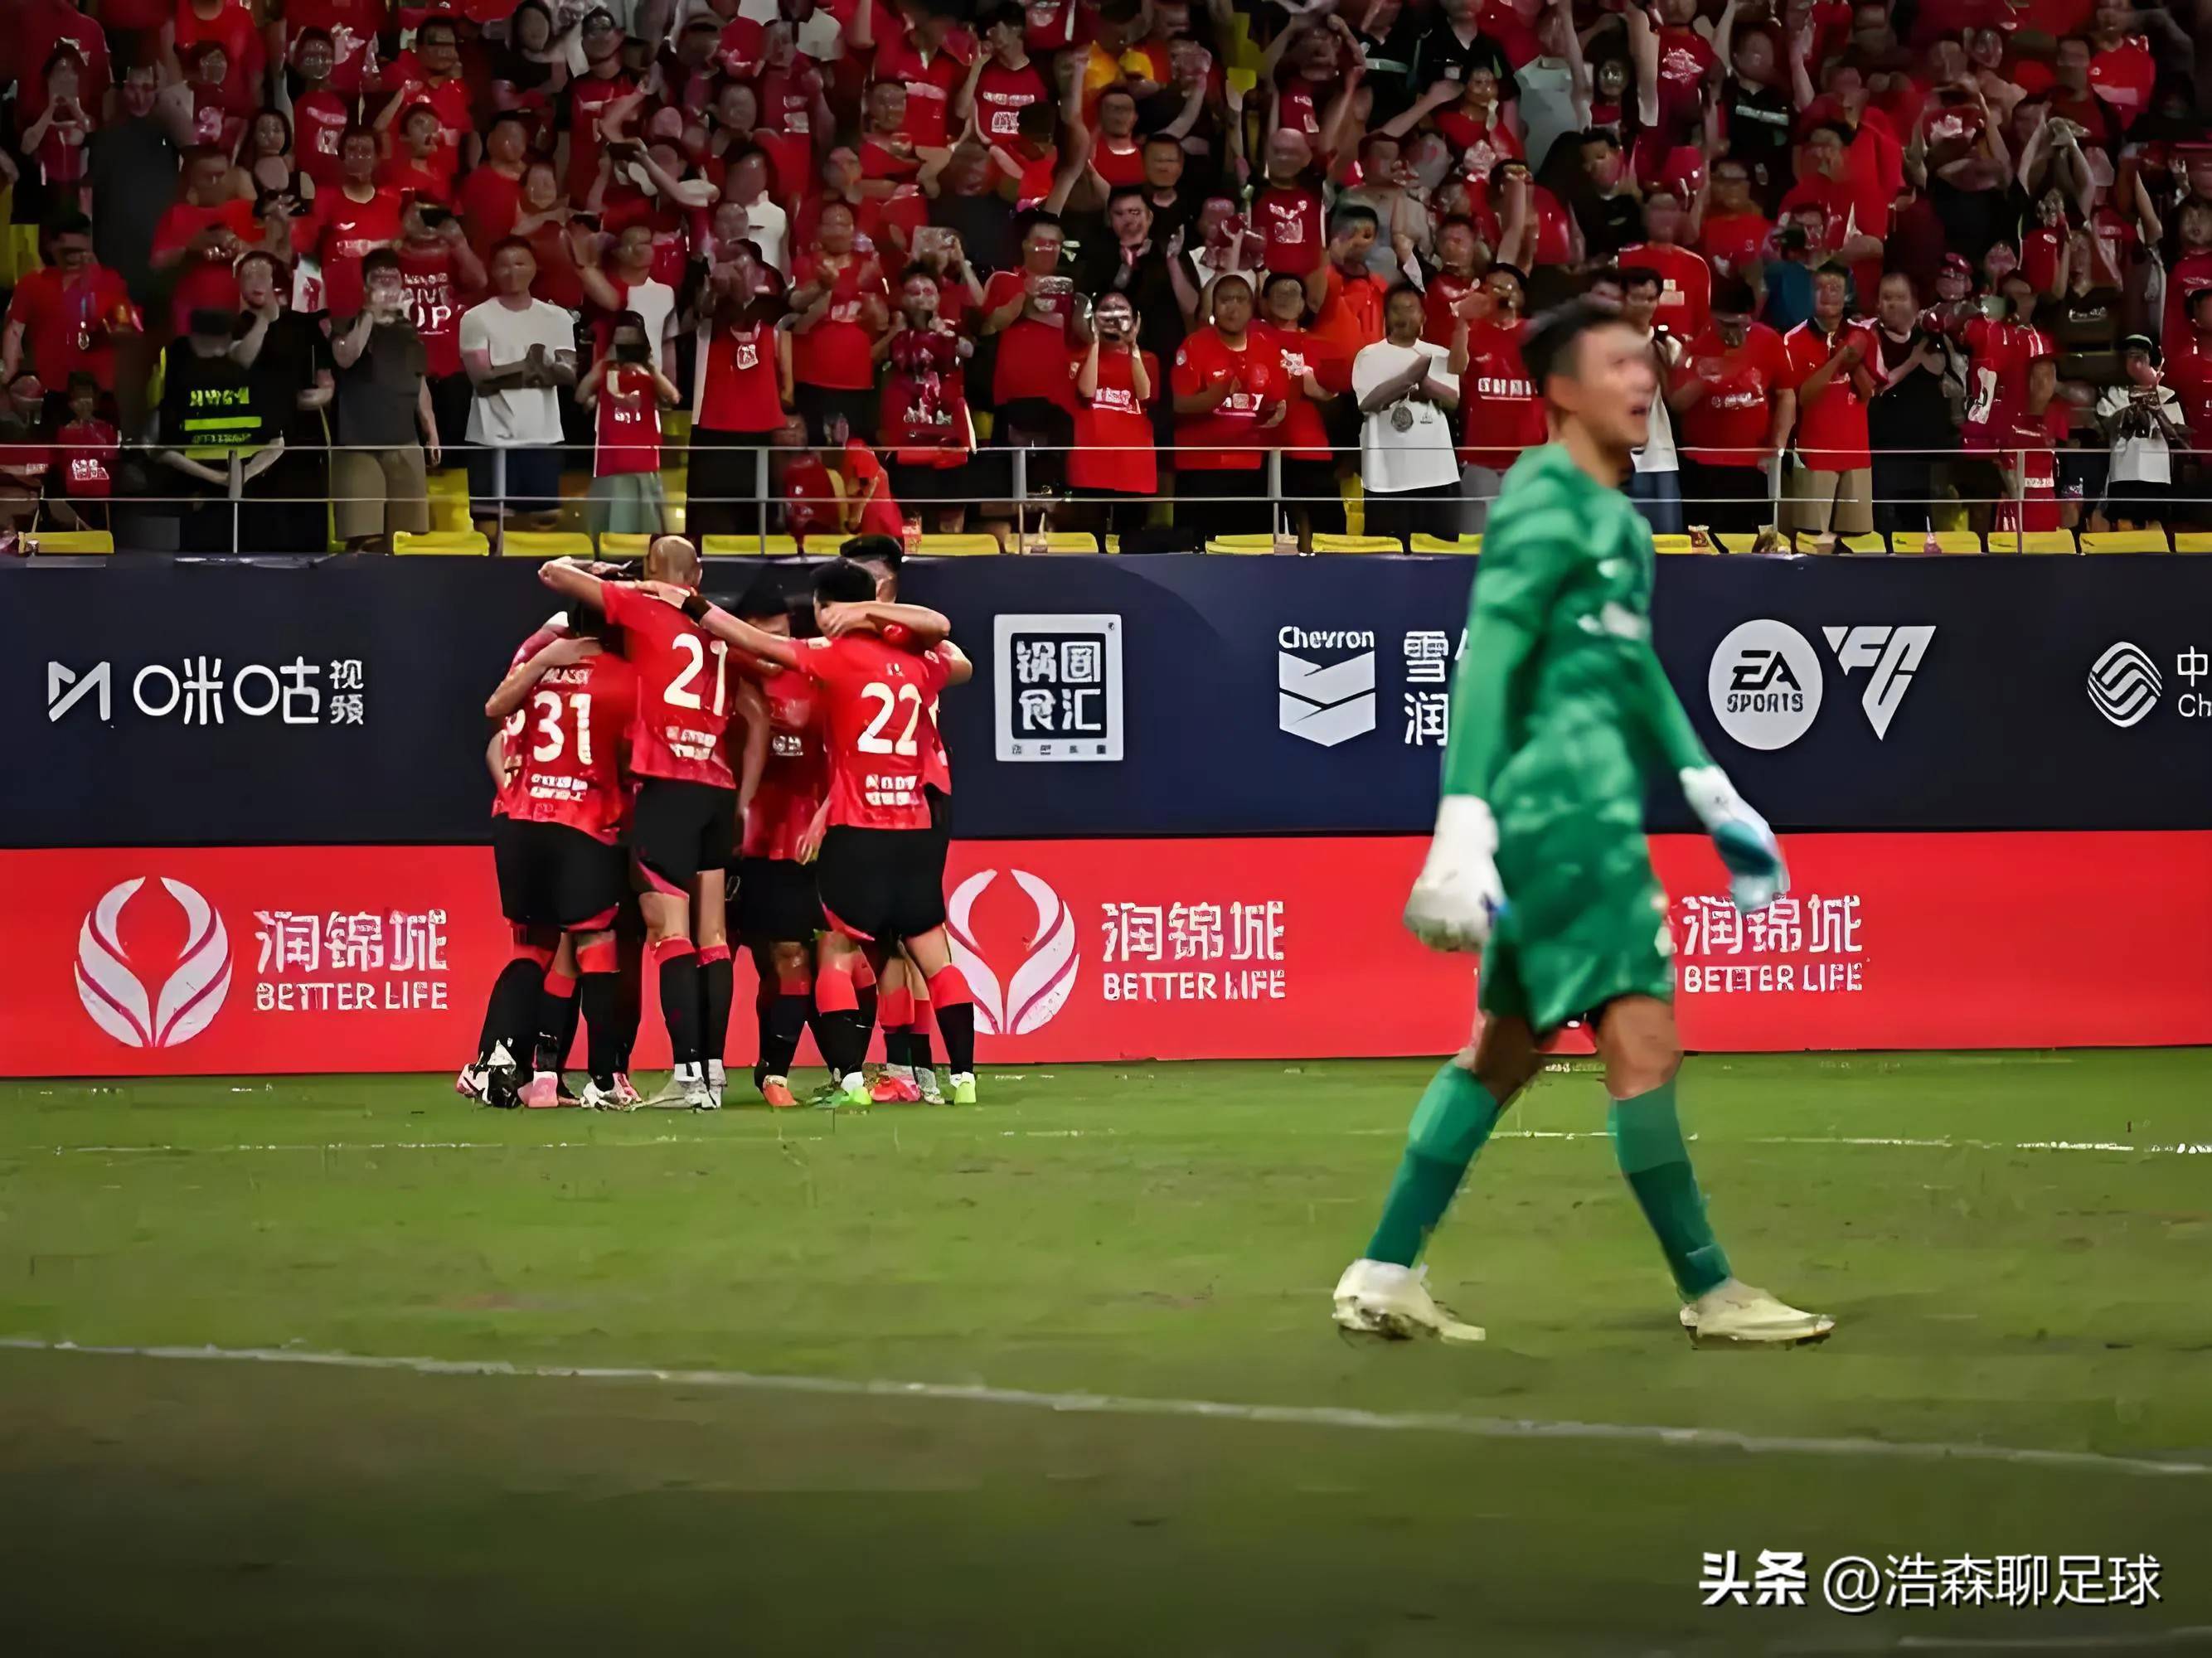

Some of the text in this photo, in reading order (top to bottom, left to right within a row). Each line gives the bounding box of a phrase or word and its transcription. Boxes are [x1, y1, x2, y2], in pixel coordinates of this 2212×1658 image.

[1278, 626, 1375, 648] Chevron
[1404, 628, 1468, 682] 雪
[663, 633, 728, 717] 21
[1729, 650, 1802, 691] EA
[2177, 646, 2209, 687] 中
[857, 681, 922, 757] 22
[1404, 691, 1449, 746] 润
[1726, 693, 1803, 712] SPORTS
[2178, 693, 2212, 717] Ch
[533, 690, 593, 765] 31
[253, 909, 449, 973] 润锦城
[1101, 901, 1284, 962] 润锦城
[1681, 894, 1863, 955] 润锦城
[255, 981, 449, 1011] BETTER LIFE
[1104, 969, 1286, 1001] BETTER LIFE
[1684, 962, 1863, 993] BETTER LIFE
